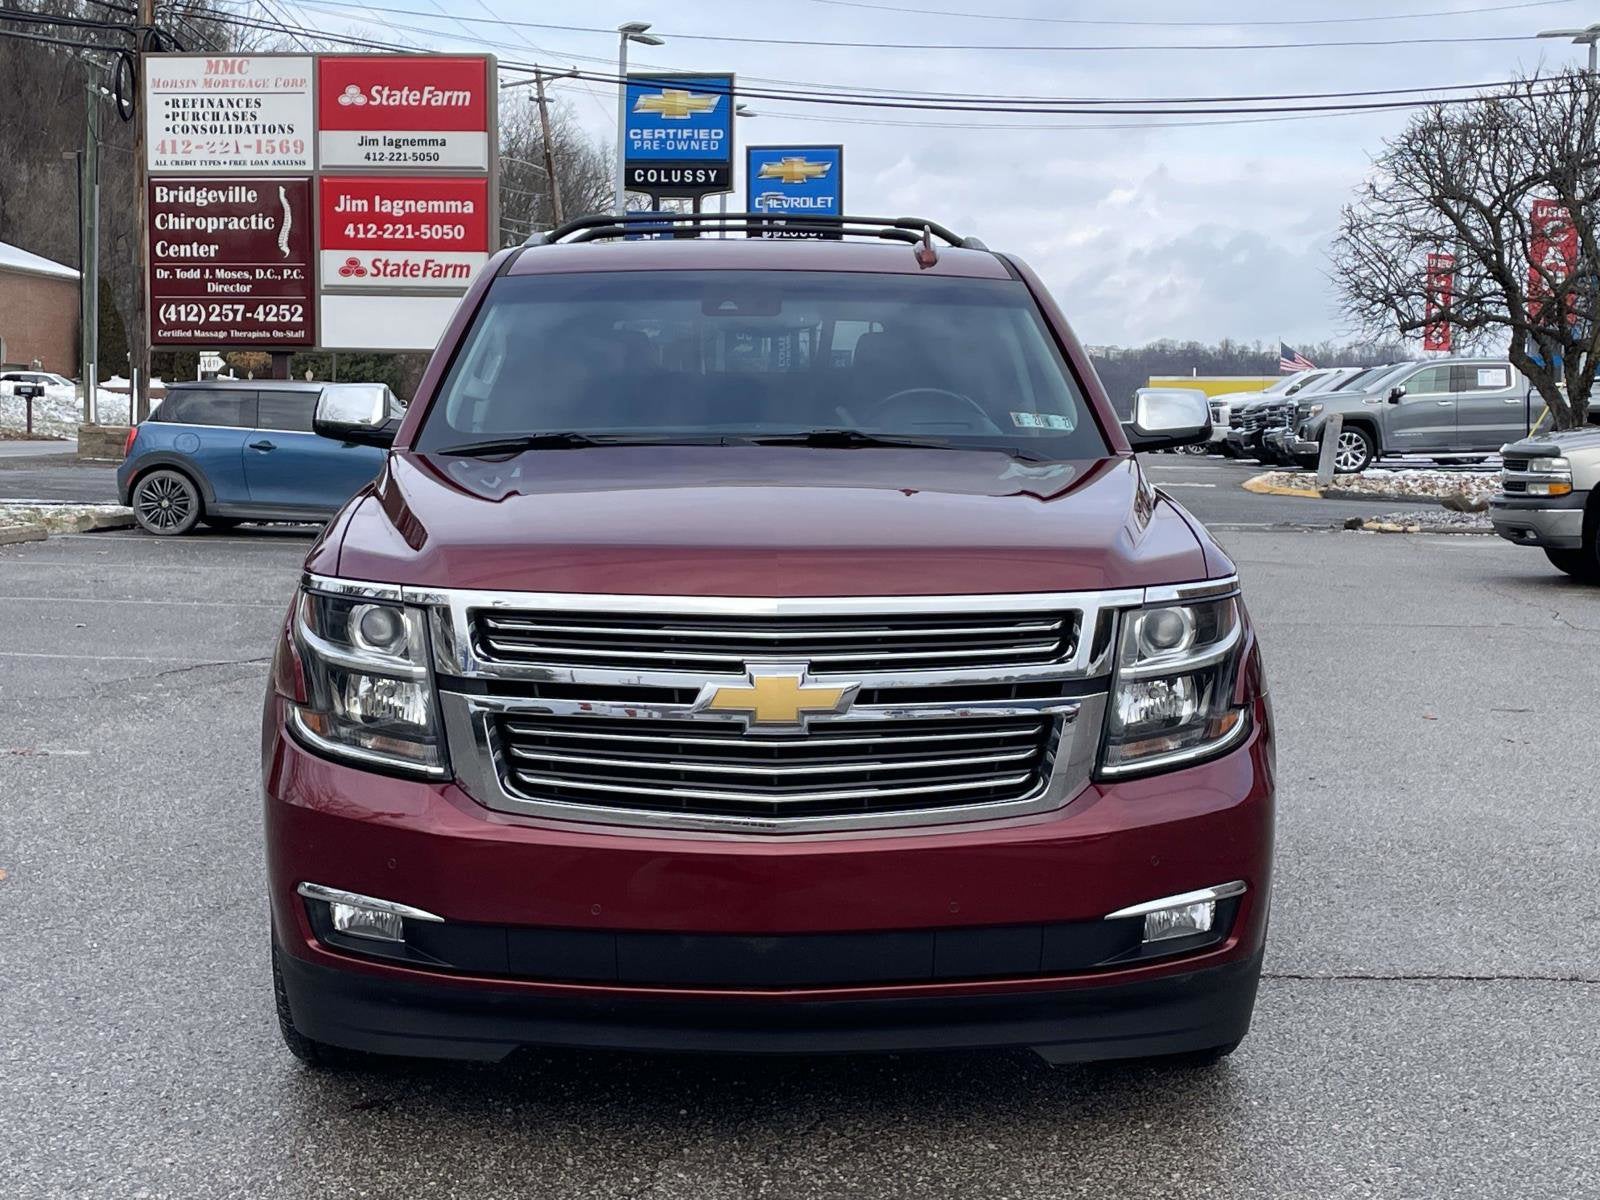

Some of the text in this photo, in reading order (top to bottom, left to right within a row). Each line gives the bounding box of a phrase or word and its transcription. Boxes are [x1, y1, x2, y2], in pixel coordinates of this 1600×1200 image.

[204, 59, 250, 75] MMC
[202, 77, 270, 88] MORTGAGE
[172, 98, 262, 108] REFINANCES
[172, 111, 257, 122] PURCHASES
[172, 124, 294, 134] CONSOLIDATIONS
[629, 129, 724, 140] CERTIFIED
[155, 139, 305, 155] 412-221-1569
[358, 135, 447, 148] Jim Iagnemma
[633, 140, 719, 150] PRE-OWNED
[364, 152, 440, 162] 412-221-5050
[634, 169, 718, 183] COLUSSY
[155, 186, 258, 207] Bridgeville
[335, 195, 474, 217] Jim Iagnemma
[154, 212, 275, 233] Chiropractic
[344, 223, 465, 240] 412-221-5050
[155, 240, 219, 258] Center
[156, 269, 173, 279] Dr.
[176, 269, 200, 279] Todd
[204, 269, 213, 279] J.
[215, 269, 253, 280] Moses,
[283, 269, 304, 280] P.C.
[207, 282, 252, 293] Director
[158, 330, 305, 339] Certified Massage Therapists On-Staff
